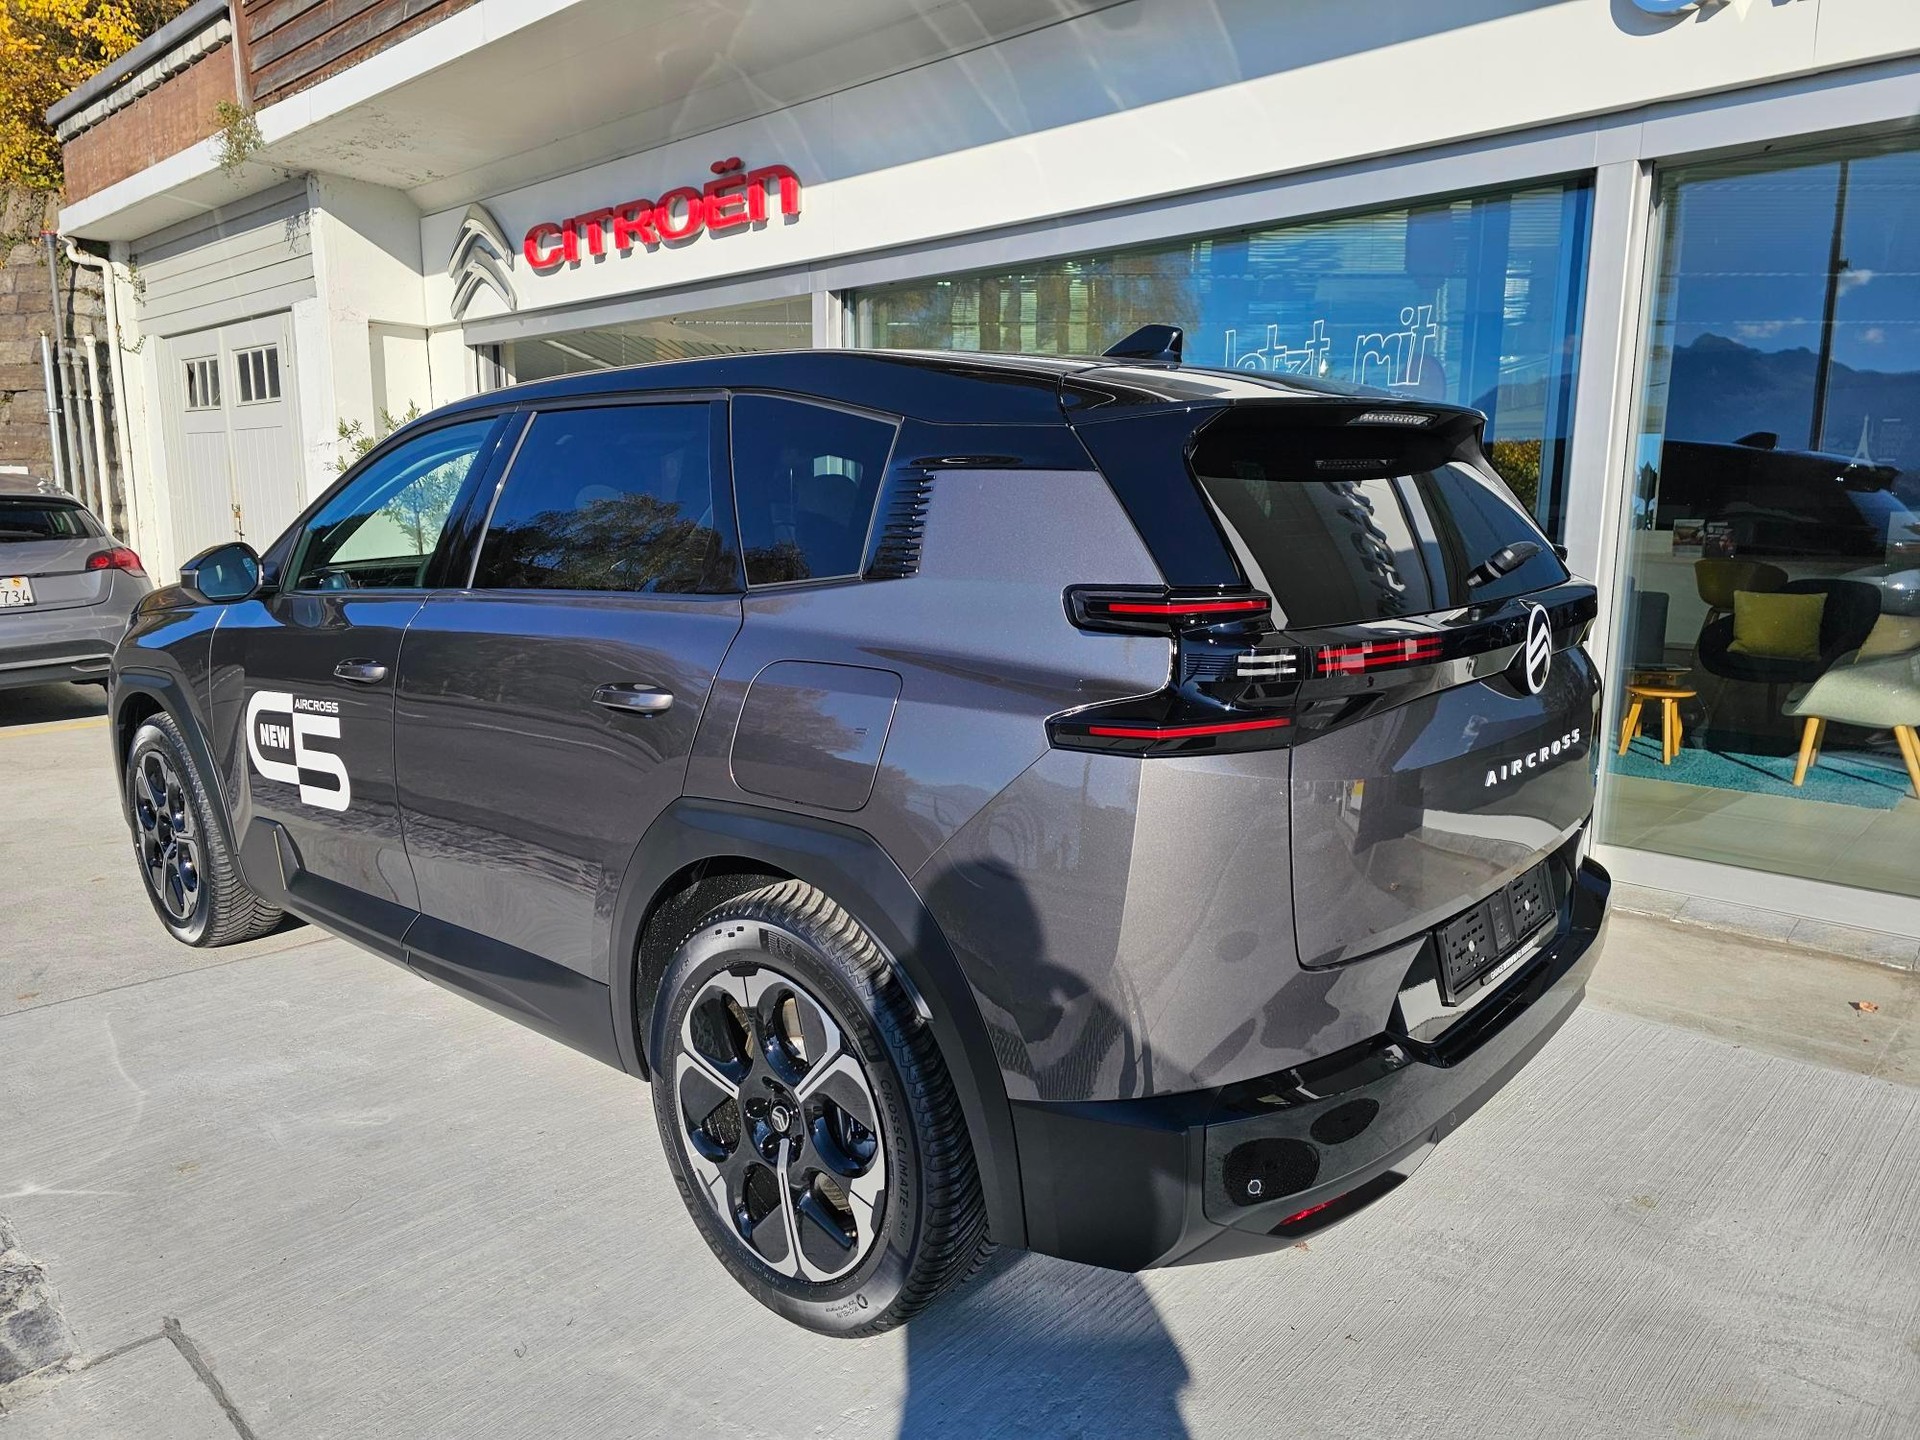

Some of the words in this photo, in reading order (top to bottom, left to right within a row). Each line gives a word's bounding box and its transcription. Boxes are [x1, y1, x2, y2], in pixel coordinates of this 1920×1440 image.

[524, 157, 802, 269] CITROËN
[1352, 305, 1437, 386] mit
[294, 698, 339, 713] AIRCROSS
[260, 723, 290, 749] NEW
[1485, 728, 1580, 787] AIRCROSS
